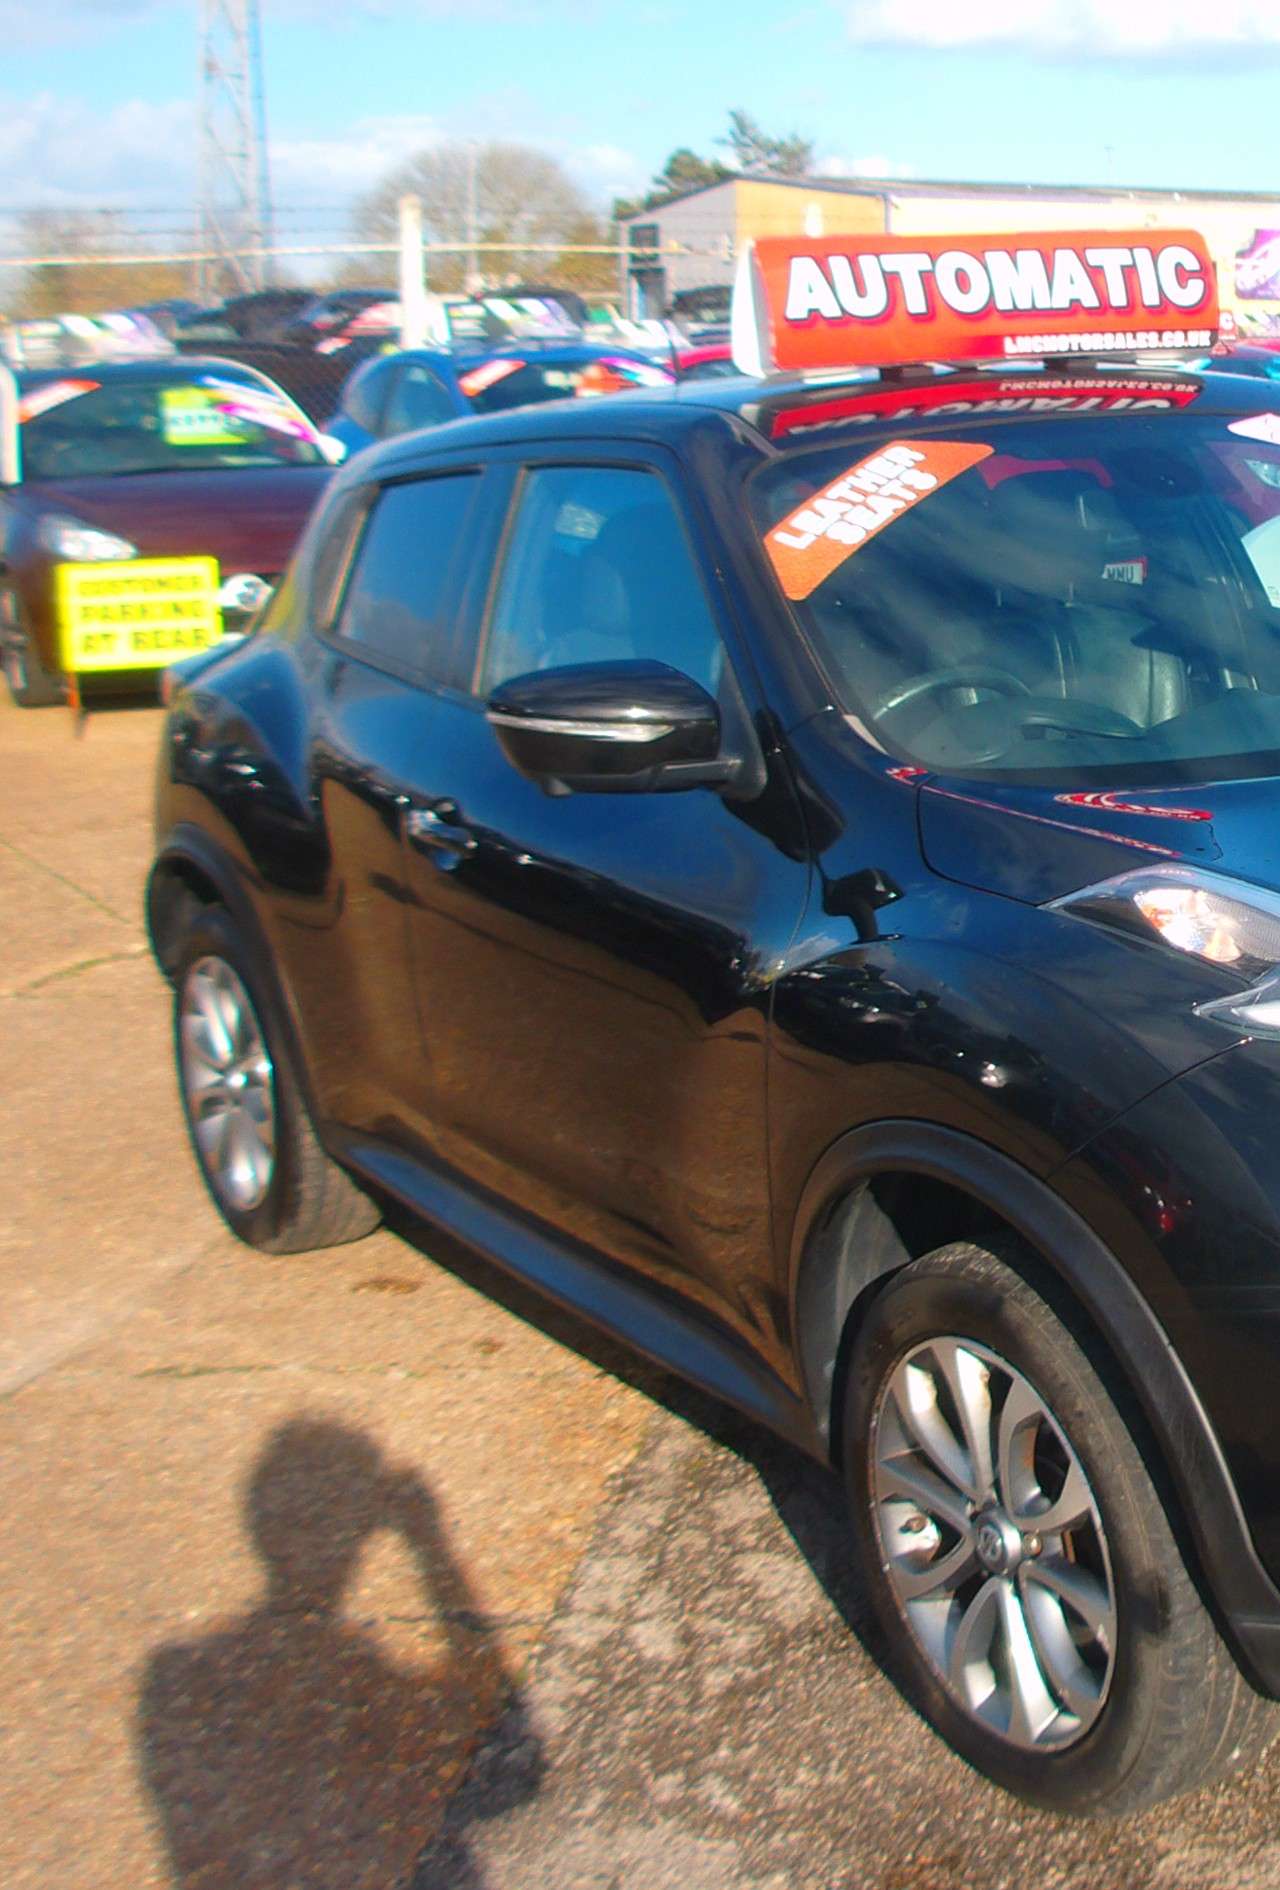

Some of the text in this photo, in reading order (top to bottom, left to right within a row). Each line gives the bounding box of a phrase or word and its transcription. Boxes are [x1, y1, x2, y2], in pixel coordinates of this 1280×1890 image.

[785, 245, 1206, 321] AUTOMATIC
[773, 446, 926, 549] LEATHER
[825, 468, 938, 544] SEATS
